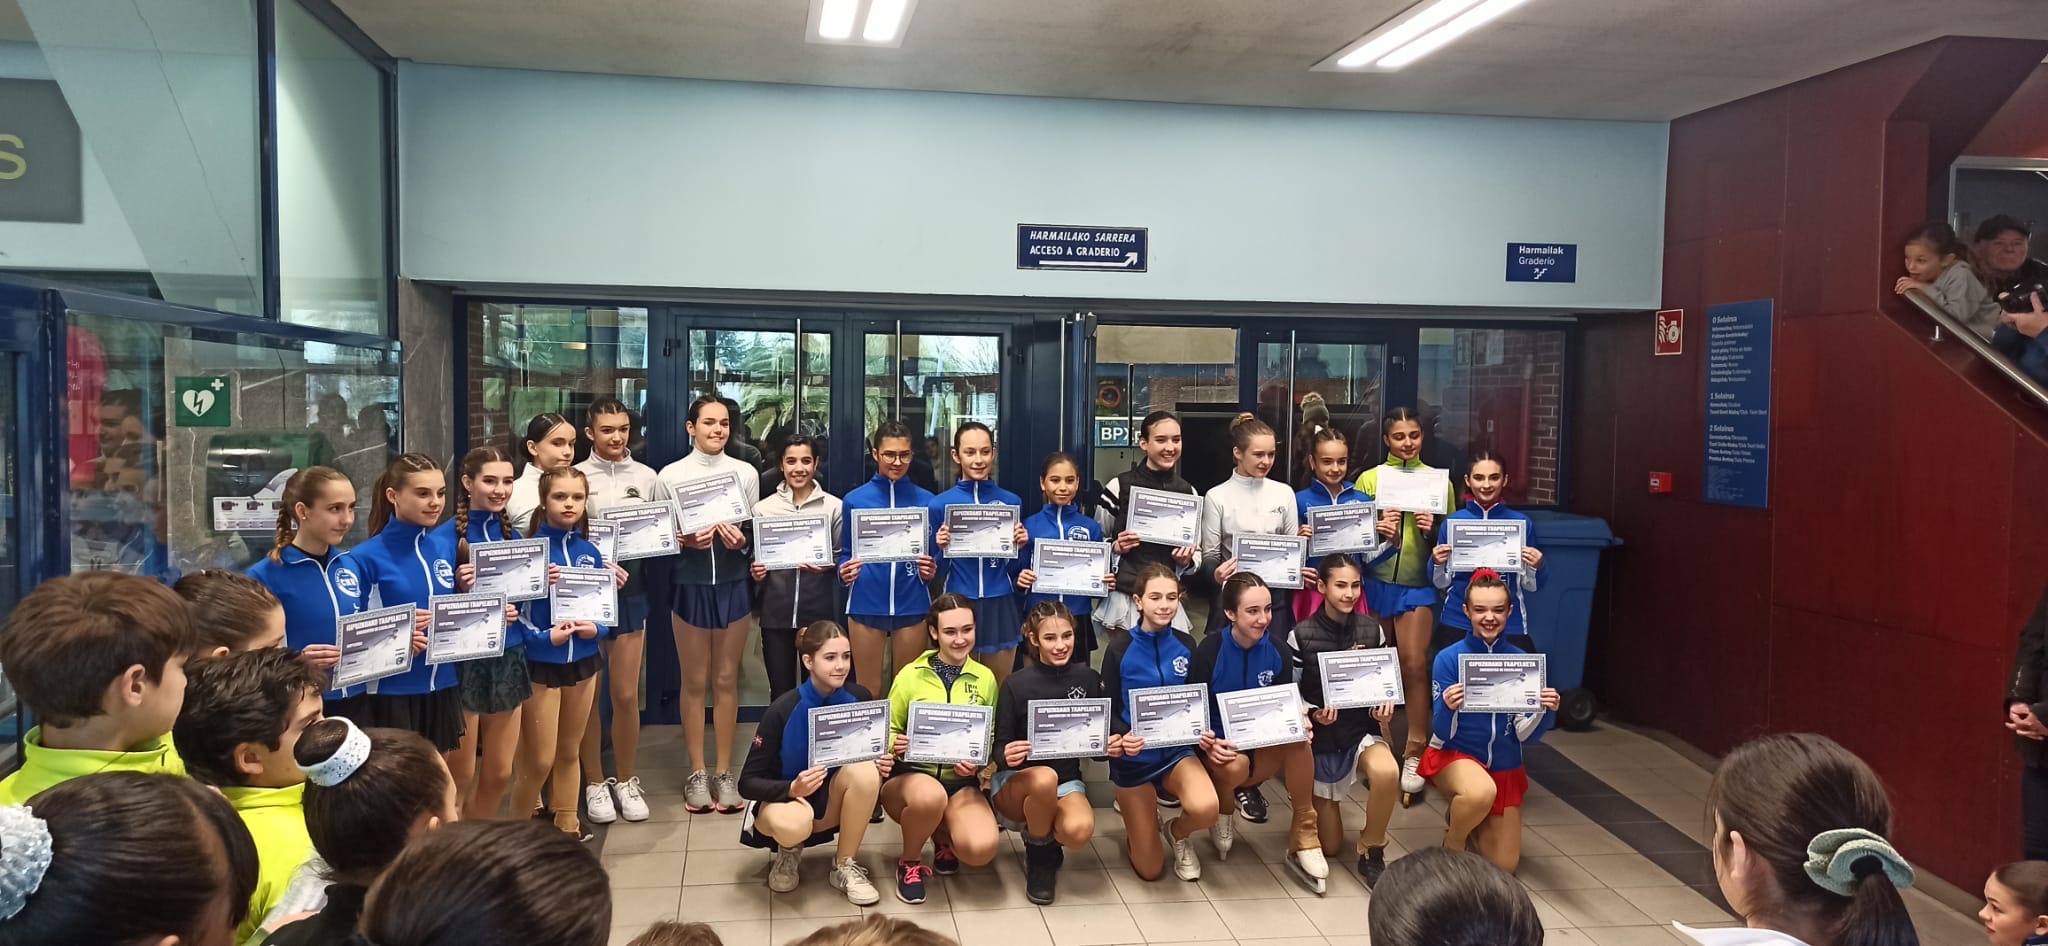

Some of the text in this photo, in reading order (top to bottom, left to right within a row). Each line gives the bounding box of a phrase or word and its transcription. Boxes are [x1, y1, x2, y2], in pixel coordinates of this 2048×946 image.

[1030, 231, 1136, 243] HARMAILAKO SARRERA
[1030, 246, 1120, 257] ACCESO A GRADERIO
[1519, 245, 1564, 254] Harmailak
[1518, 256, 1555, 266] Graderío
